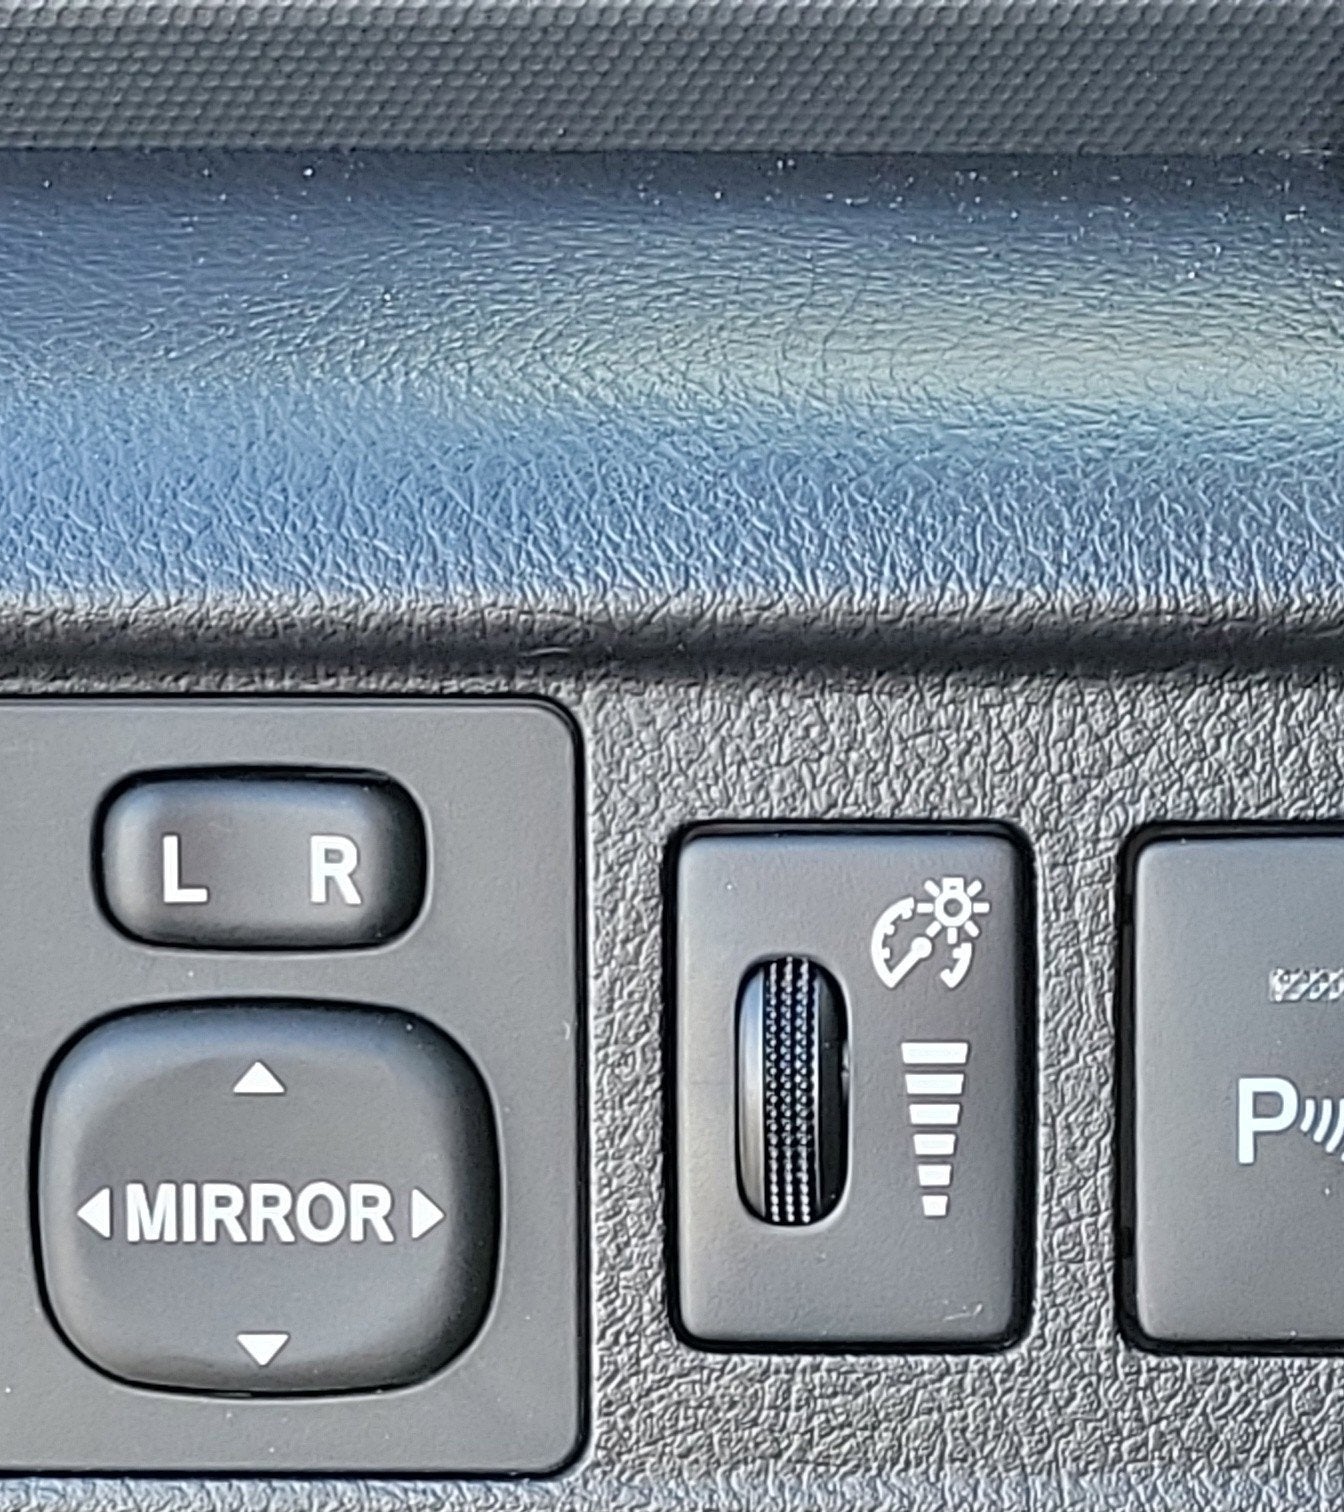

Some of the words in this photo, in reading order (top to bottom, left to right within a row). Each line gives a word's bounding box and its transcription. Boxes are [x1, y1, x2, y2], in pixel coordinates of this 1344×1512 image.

[162, 834, 209, 904] L
[309, 834, 362, 906] R
[1237, 1076, 1298, 1165] P
[125, 1181, 395, 1243] MIRROR
